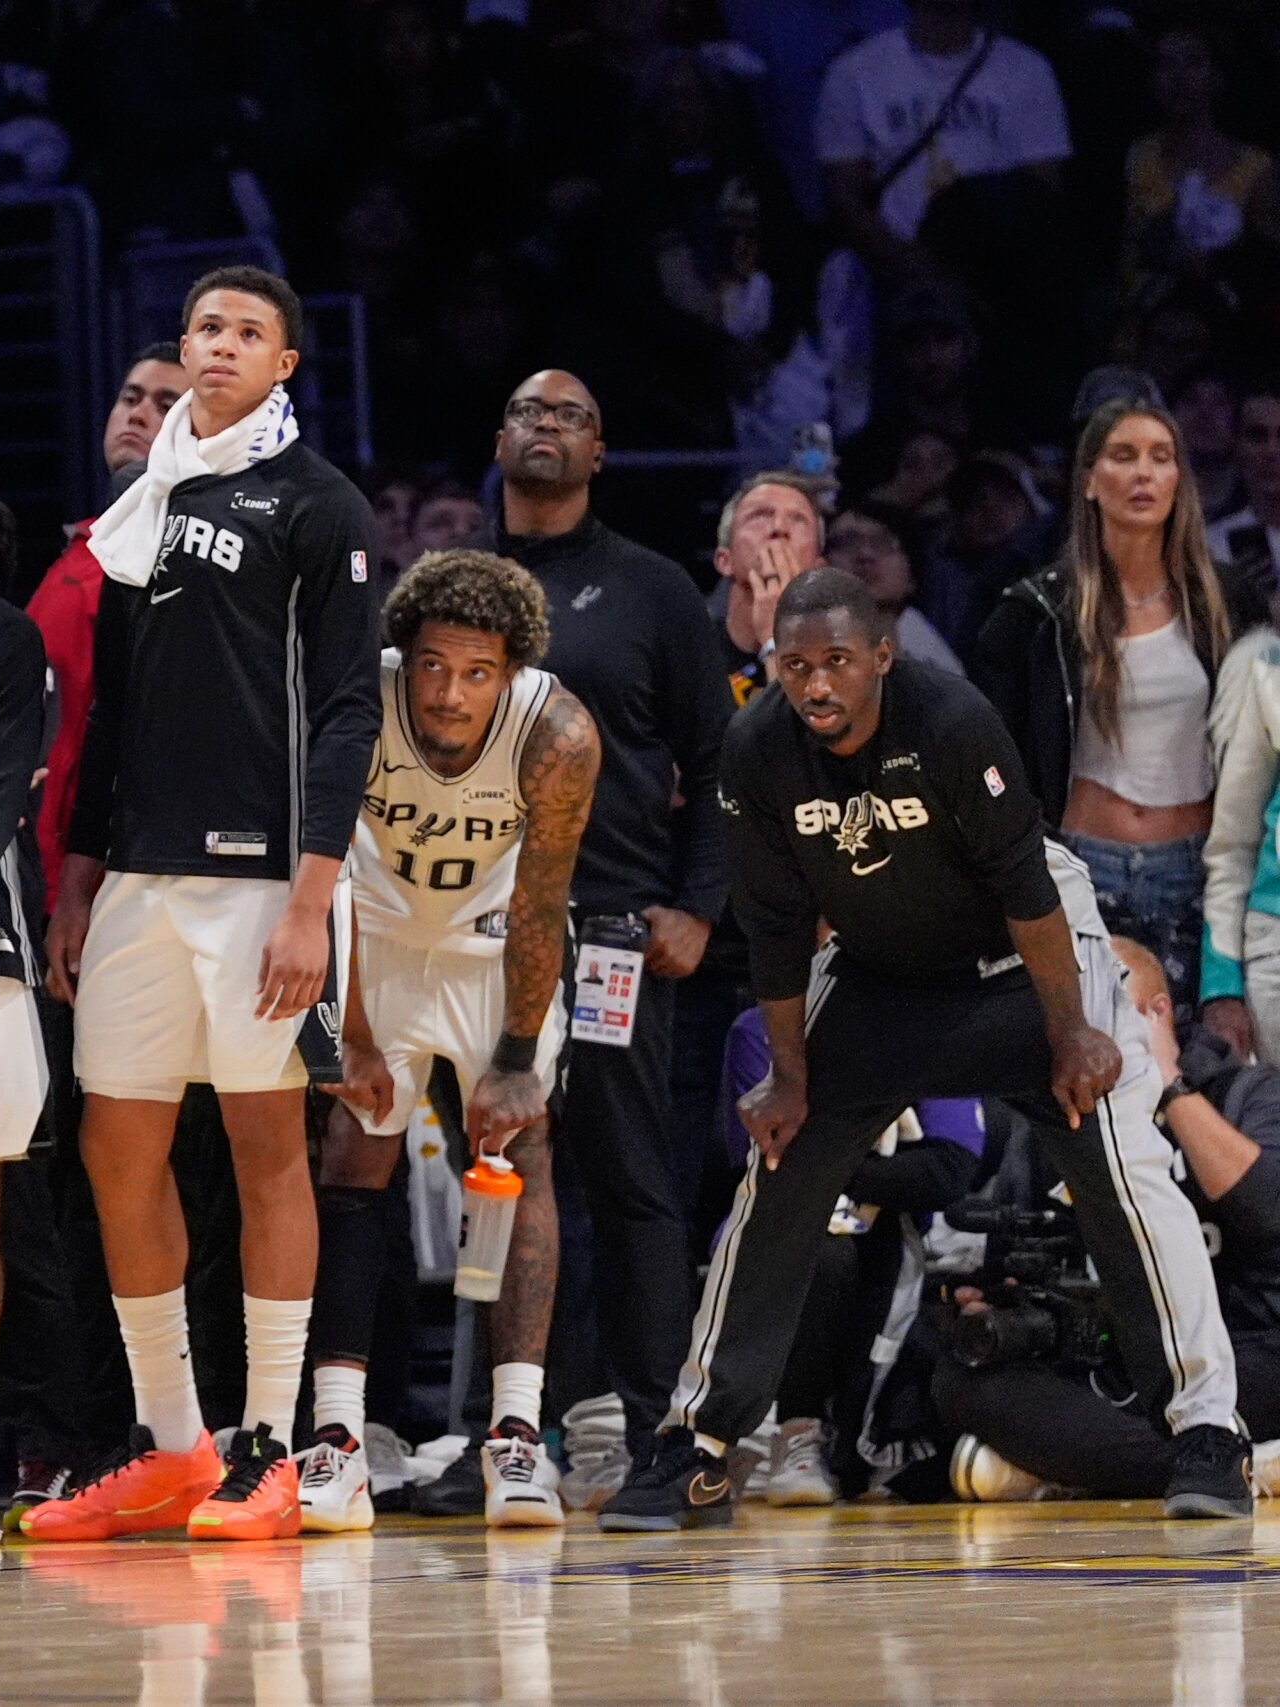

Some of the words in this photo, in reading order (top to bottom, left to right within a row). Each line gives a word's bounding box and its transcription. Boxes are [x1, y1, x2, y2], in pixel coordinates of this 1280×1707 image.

[238, 497, 272, 510] LEDGER
[468, 790, 505, 800] LEDGER
[794, 790, 929, 856] SPURS
[392, 848, 478, 891] 10
